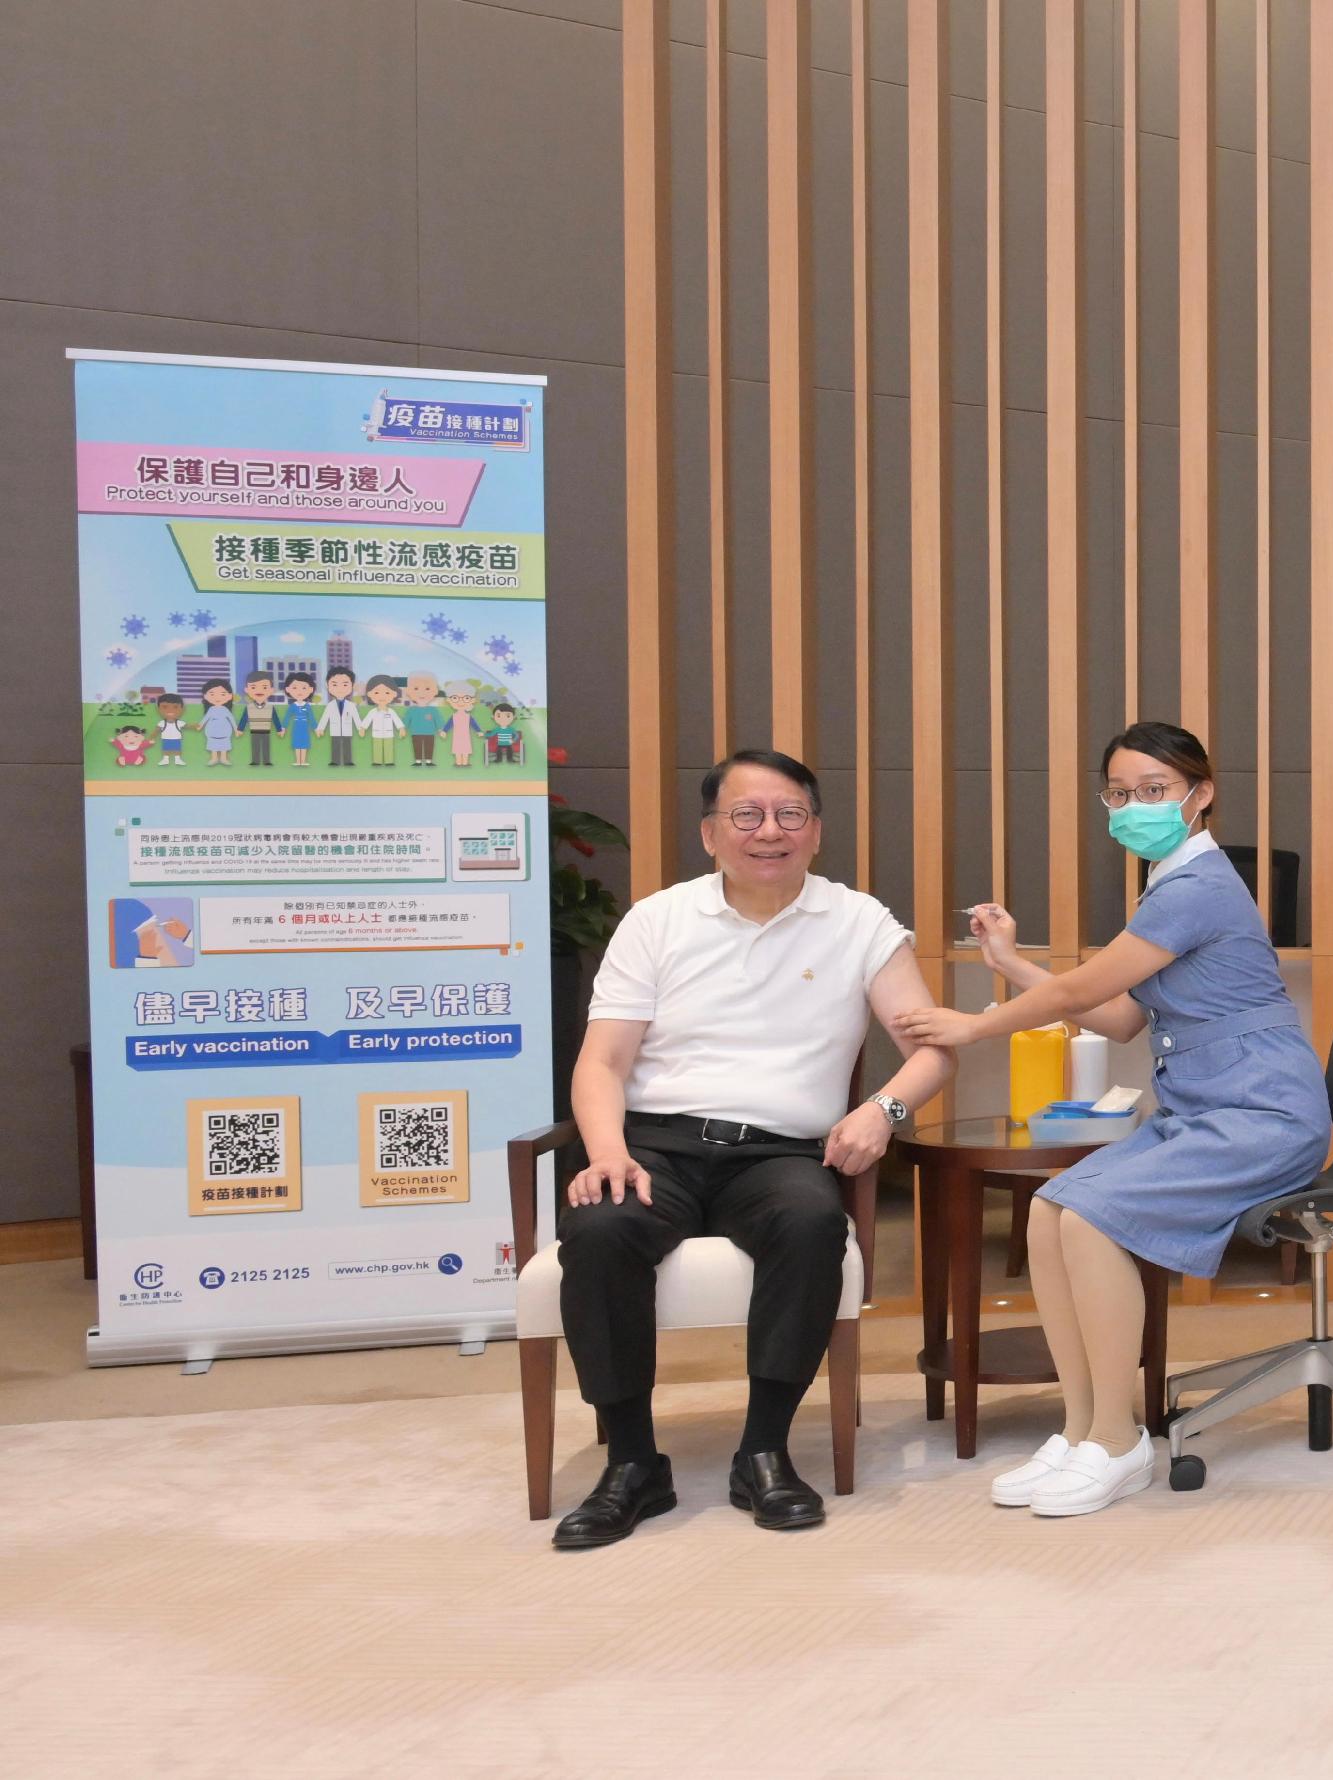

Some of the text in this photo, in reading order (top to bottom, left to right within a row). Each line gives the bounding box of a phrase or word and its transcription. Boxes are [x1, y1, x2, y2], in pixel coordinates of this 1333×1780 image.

[387, 404, 519, 432] 疫苗接種計劃
[410, 428, 518, 440] Vaccination Schemes
[137, 456, 414, 495] 保護自己和身邊人
[107, 486, 445, 513] Protect yourself and those around you
[214, 535, 517, 571] 接種季節性流感疫苗
[218, 565, 517, 587] Get seasonal influenza vaccination
[278, 914, 286, 924] 6
[291, 912, 382, 925] 個月或以上人士
[134, 987, 308, 1026] 儘早接種
[345, 983, 511, 1019] 及早保護
[134, 1037, 310, 1058] Early vaccination
[349, 1030, 513, 1051] Early protection
[371, 1174, 458, 1186] Vaccination
[382, 1185, 447, 1196] Schemes
[201, 1185, 289, 1201] 疫苗接種計劃
[231, 1267, 310, 1283] 2125 2125
[335, 1261, 430, 1275] www.chp.gov.hk
